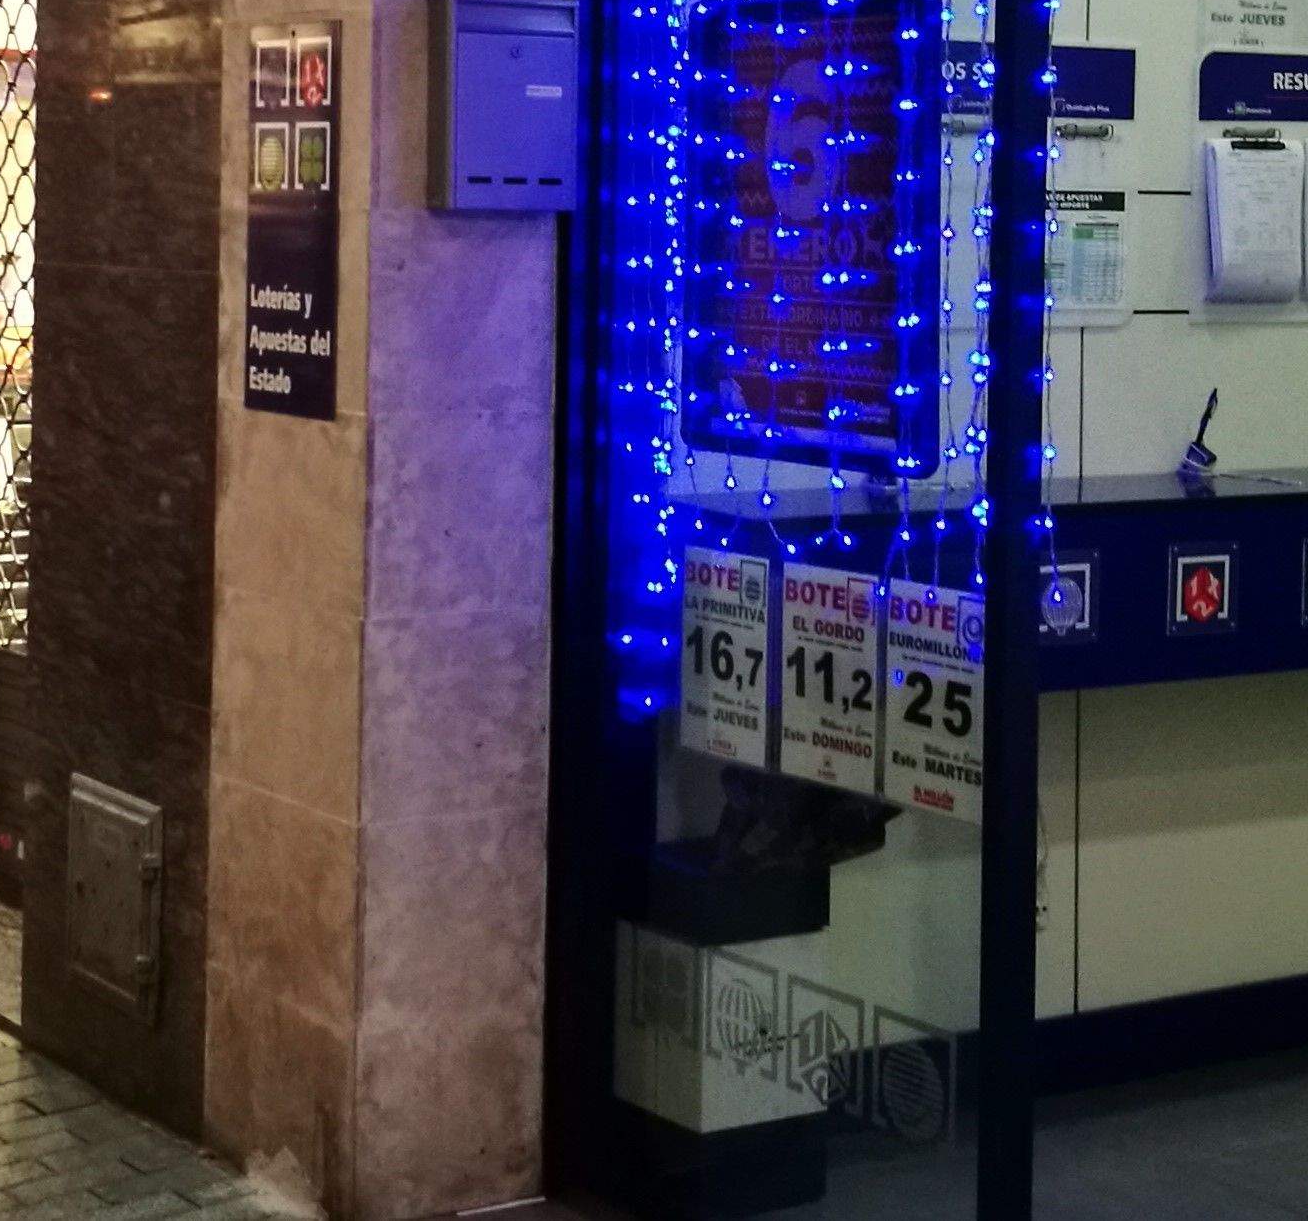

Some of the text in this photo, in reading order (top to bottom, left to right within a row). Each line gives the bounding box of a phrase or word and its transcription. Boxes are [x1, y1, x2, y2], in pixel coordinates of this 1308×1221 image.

[1240, 13, 1286, 27] JUEVES
[250, 283, 313, 320] Loterías y
[249, 325, 331, 357] Apuestas del
[249, 365, 292, 395] Estado
[685, 560, 740, 591] BOTE
[785, 577, 846, 611] BOTE
[702, 597, 766, 623] PRIMITIVA
[890, 596, 956, 632] BOTE
[793, 615, 865, 643] EL GORDO
[686, 625, 764, 692] 16,7
[787, 646, 872, 714] 11,2
[713, 708, 759, 731] JUEVES
[904, 671, 973, 738] 25
[812, 731, 873, 759] DOMINGO
[925, 757, 982, 786] MARTES
